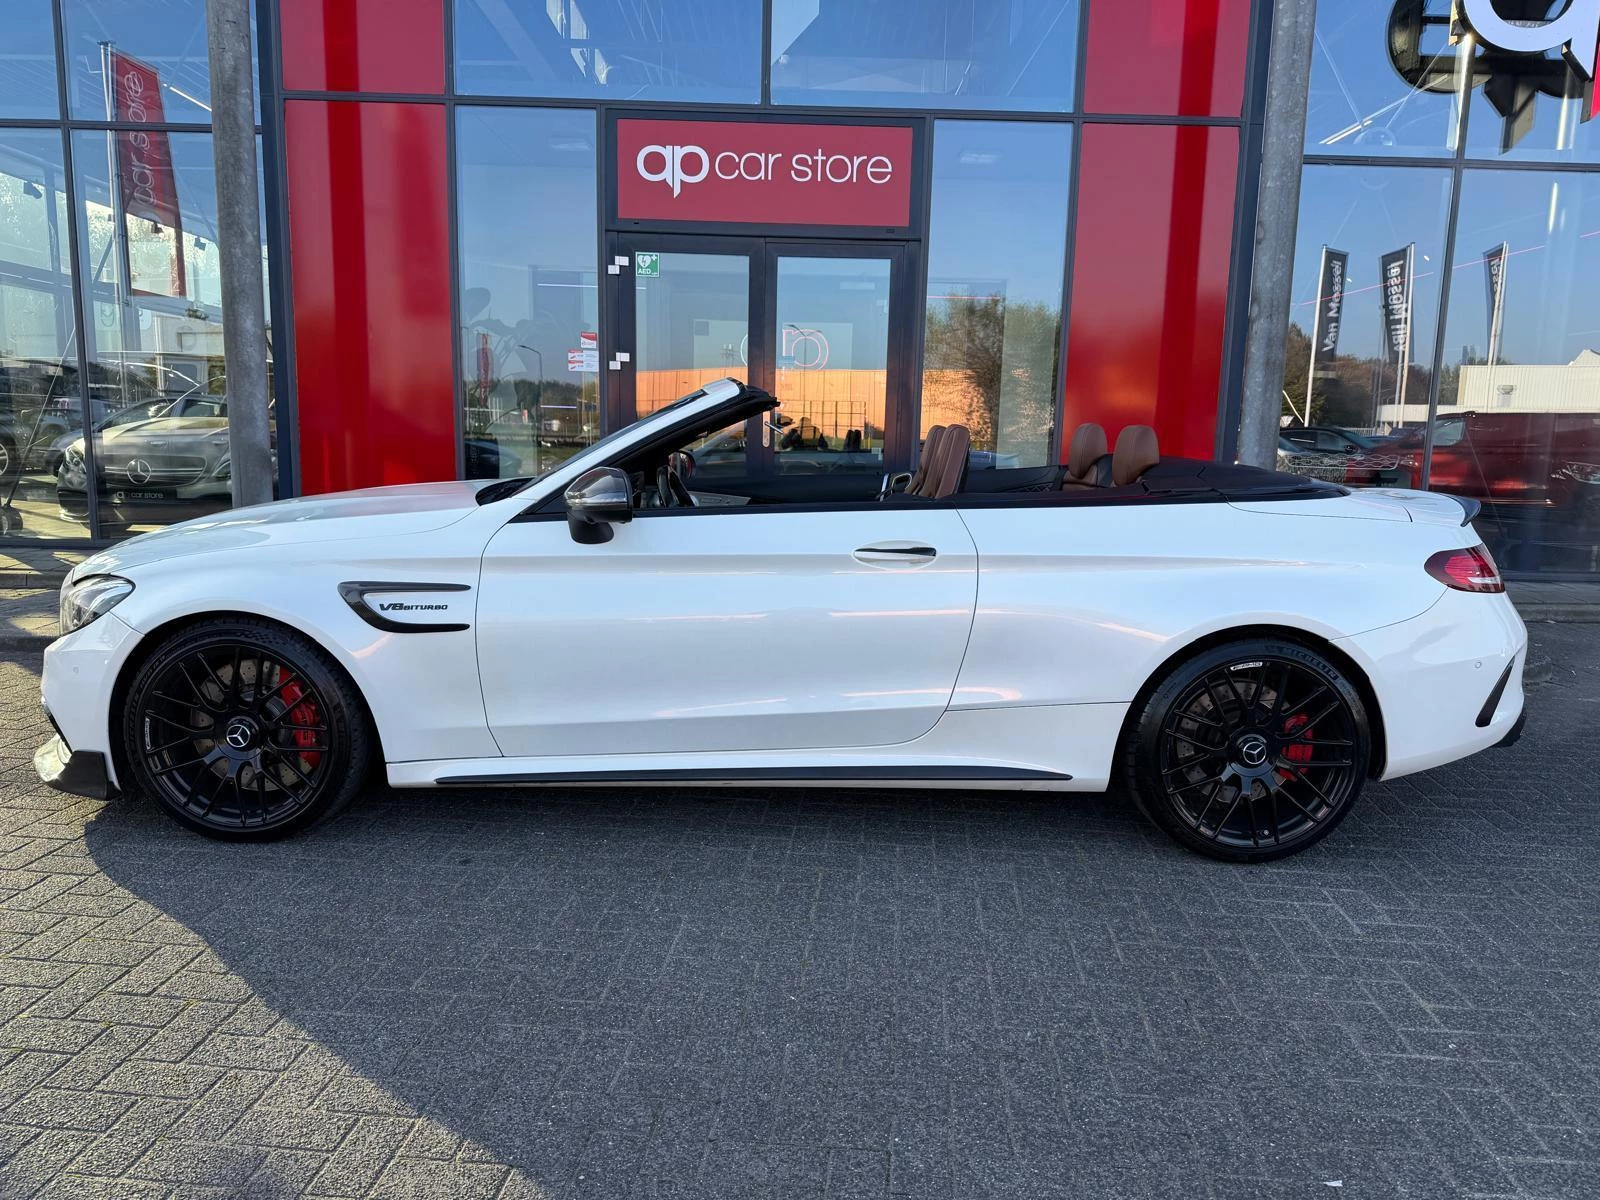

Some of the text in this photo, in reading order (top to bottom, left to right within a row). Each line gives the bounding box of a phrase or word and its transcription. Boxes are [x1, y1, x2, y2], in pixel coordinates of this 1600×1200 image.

[123, 71, 151, 151] sore
[715, 151, 782, 181] car
[790, 148, 893, 184] store
